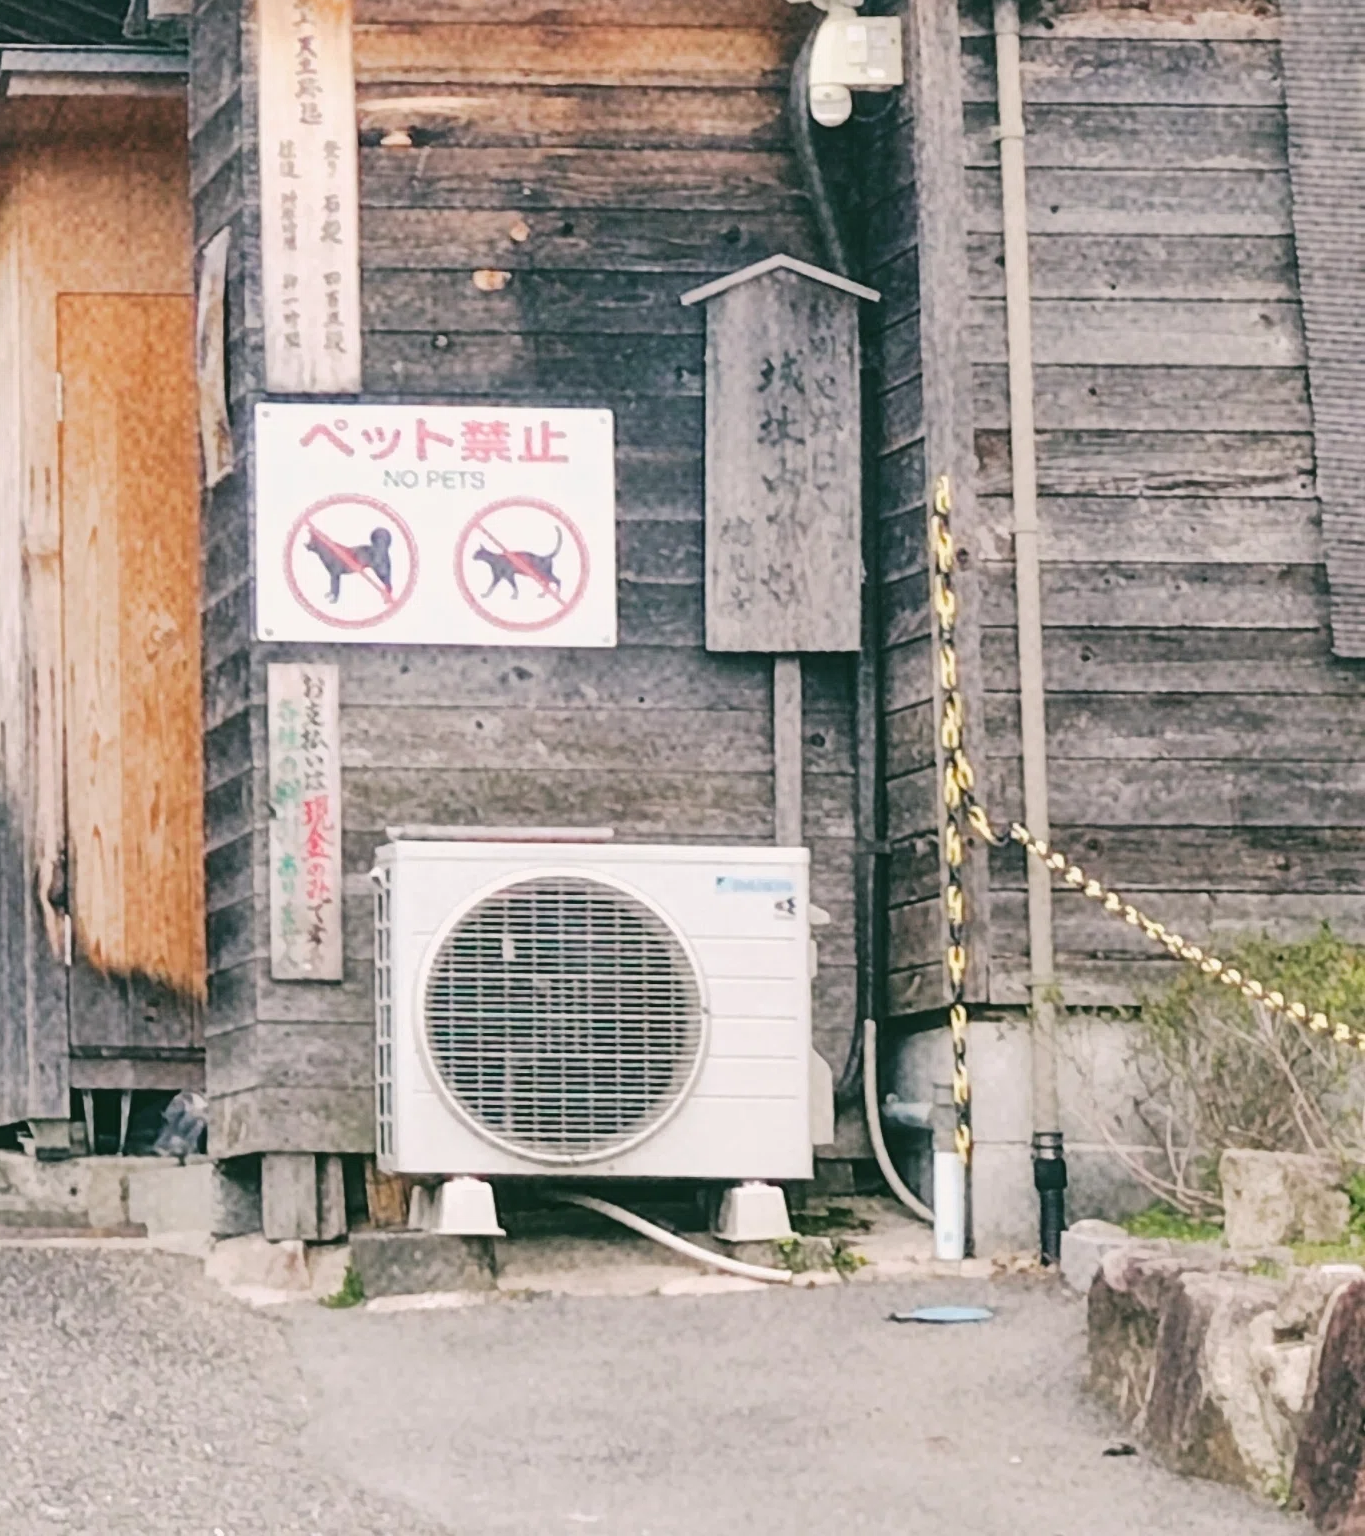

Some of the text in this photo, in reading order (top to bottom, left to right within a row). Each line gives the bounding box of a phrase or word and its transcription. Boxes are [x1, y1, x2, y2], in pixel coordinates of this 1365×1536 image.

[299, 418, 569, 464] ペット禁止
[383, 469, 485, 490] NO PETS
